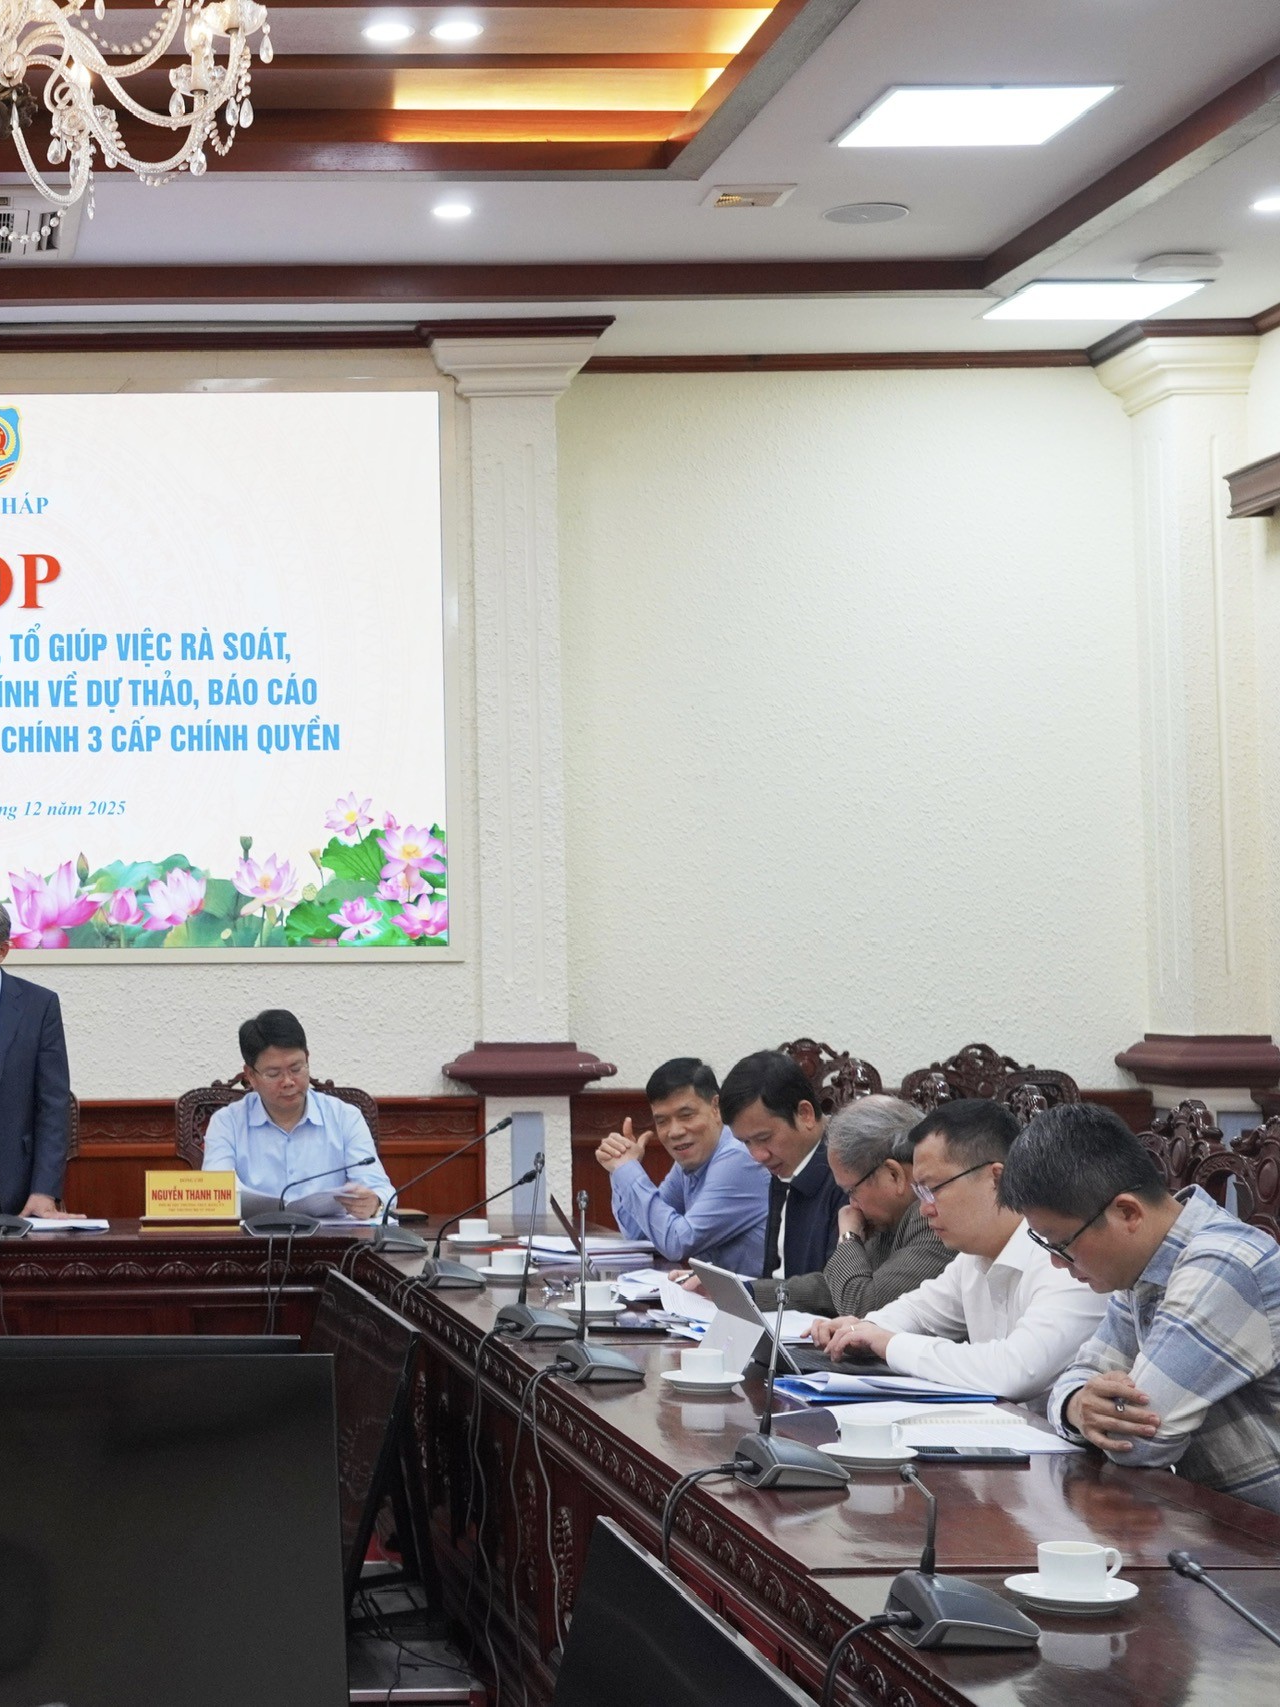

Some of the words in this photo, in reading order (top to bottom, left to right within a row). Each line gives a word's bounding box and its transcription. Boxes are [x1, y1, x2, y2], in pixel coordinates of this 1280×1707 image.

[9, 623, 41, 662] TỔ
[48, 628, 108, 662] GIÚP
[116, 627, 172, 668] VIỆC
[181, 627, 214, 660] RÀ
[223, 626, 291, 663] SOÁT,
[47, 671, 78, 707] VỀ
[87, 677, 123, 713] DỰ
[128, 670, 199, 710] THẢO,
[208, 673, 258, 706] BÁO
[267, 672, 318, 705] CÁO
[1, 720, 79, 753] CHÍNH
[88, 725, 102, 752] 3
[111, 716, 161, 752] CẤP
[170, 719, 248, 752] CHÍNH
[257, 715, 340, 755] QUYỀN
[24, 801, 42, 816] 12
[47, 801, 82, 816] năm
[88, 800, 126, 816] 2025
[151, 1186, 183, 1201] NGUYỄN
[186, 1189, 212, 1201] THANH
[214, 1189, 232, 1203] TỊNH
